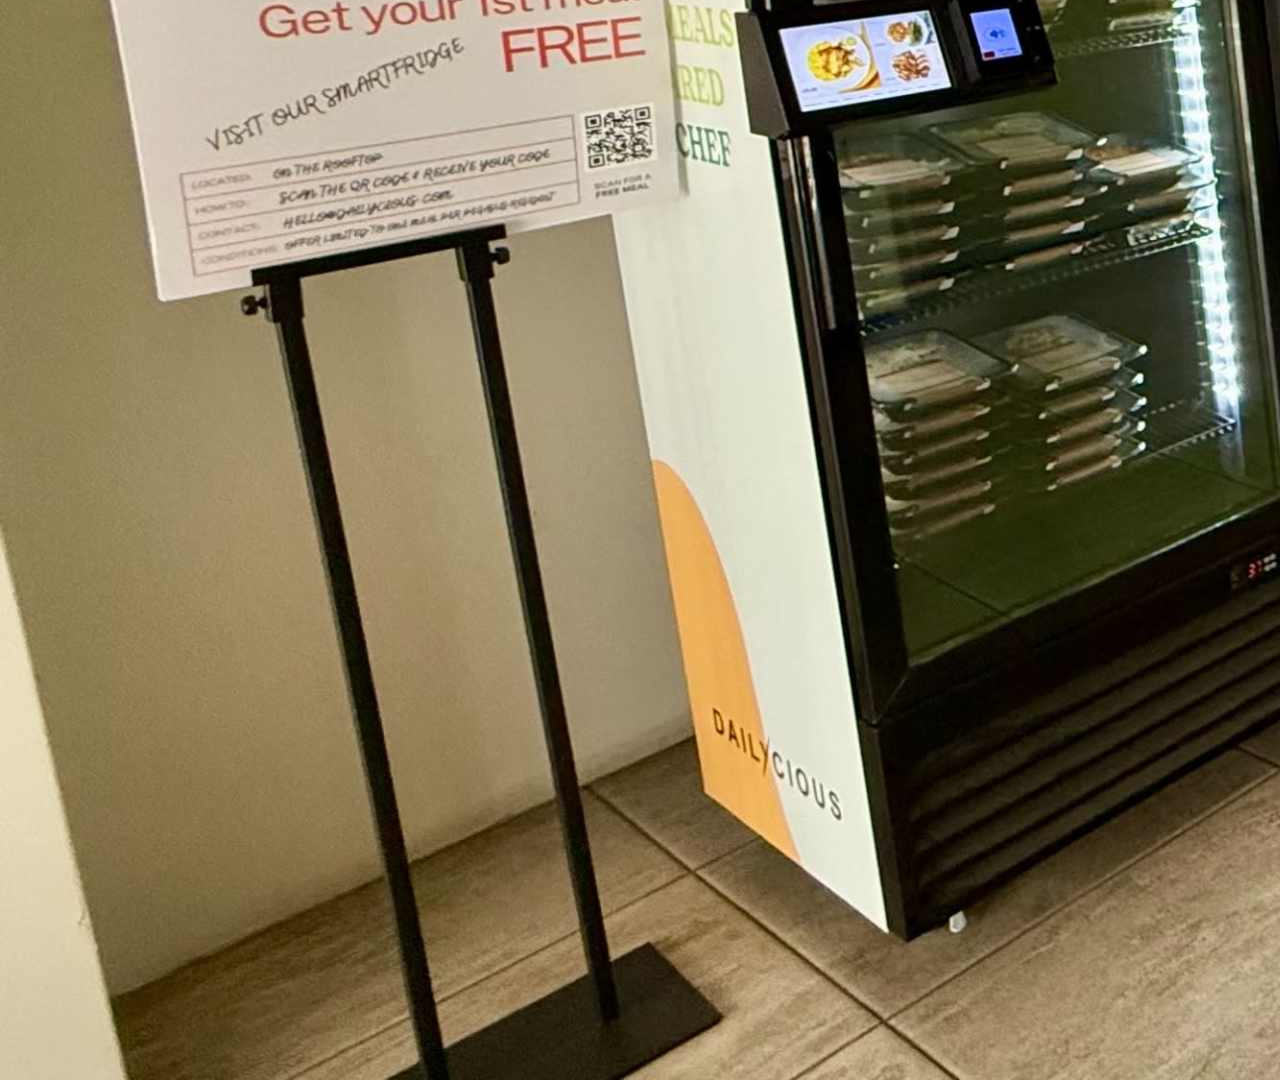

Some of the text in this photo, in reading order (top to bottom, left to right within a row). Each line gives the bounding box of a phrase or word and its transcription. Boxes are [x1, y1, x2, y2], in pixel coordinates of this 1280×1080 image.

[258, 1, 353, 40] Get
[500, 16, 647, 73] FREE
[205, 37, 465, 152] VISIT OUR SMARTFRIDGE
[675, 122, 731, 167] CHEF
[319, 179, 348, 194] THE
[350, 178, 371, 192] QR
[712, 706, 843, 822] DAILYCIOUS
